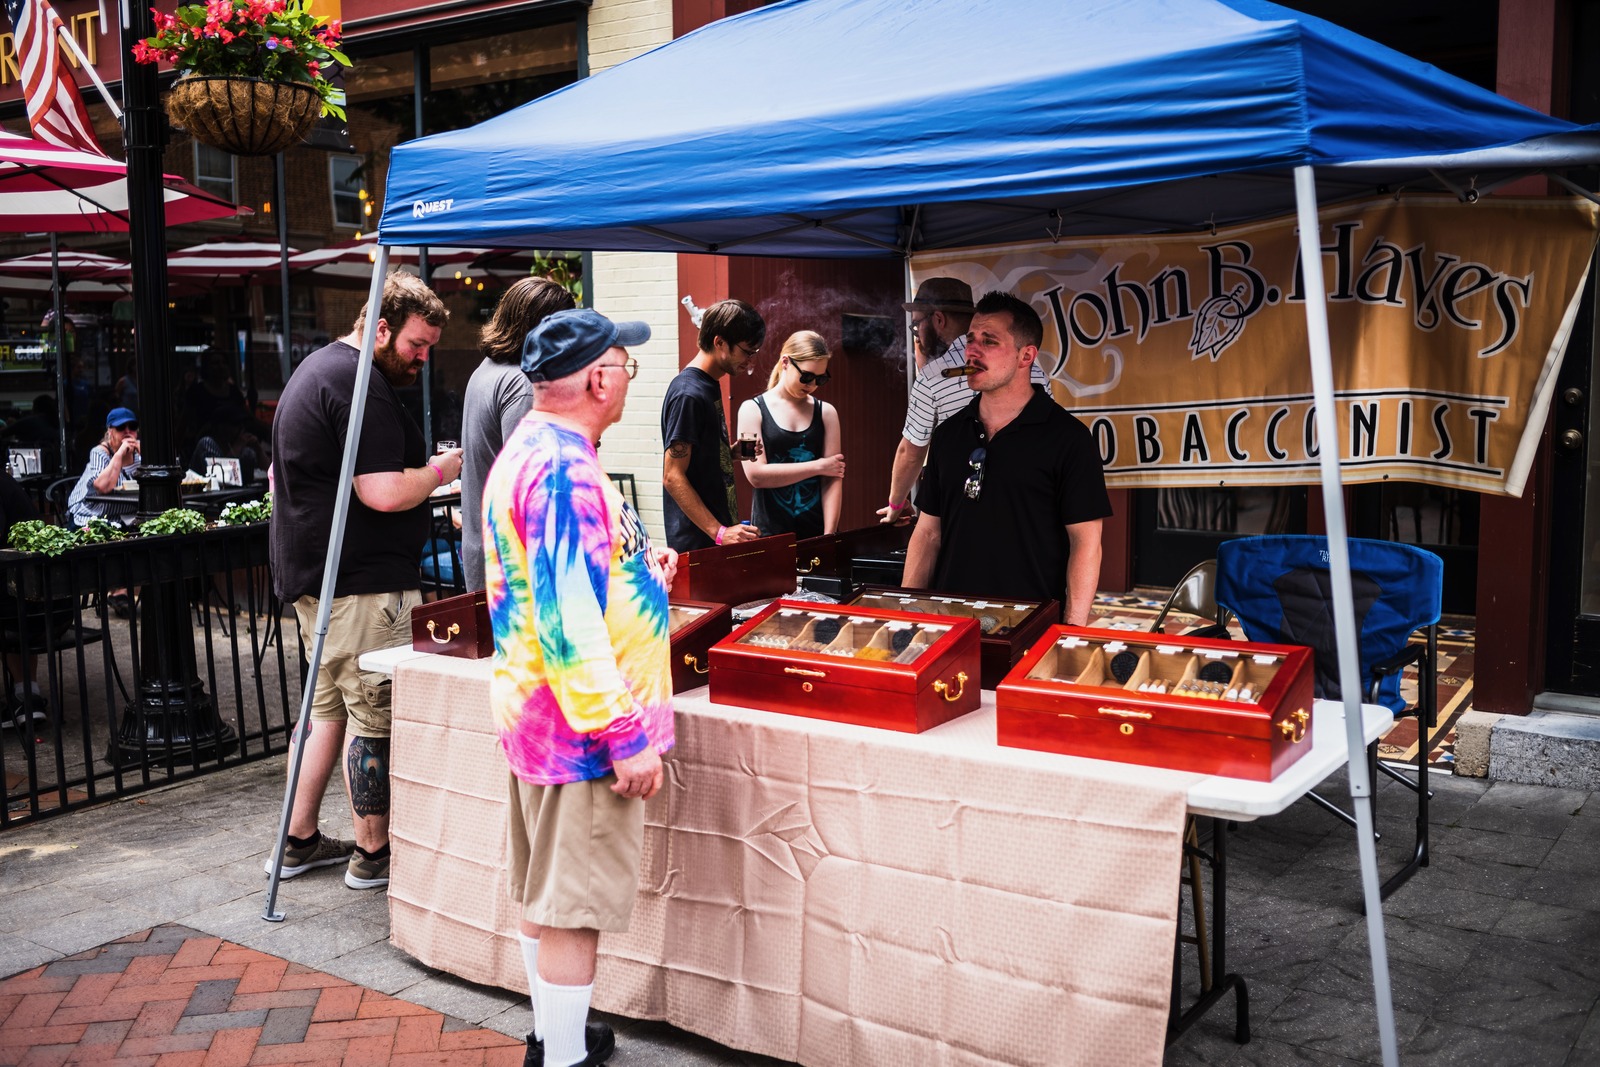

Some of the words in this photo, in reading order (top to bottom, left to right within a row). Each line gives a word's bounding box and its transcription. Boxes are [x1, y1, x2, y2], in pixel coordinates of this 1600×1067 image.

[412, 199, 454, 218] QUEST
[1042, 264, 1194, 377] John
[1200, 241, 1280, 319] B.
[1091, 401, 1498, 466] OBACCONIST
